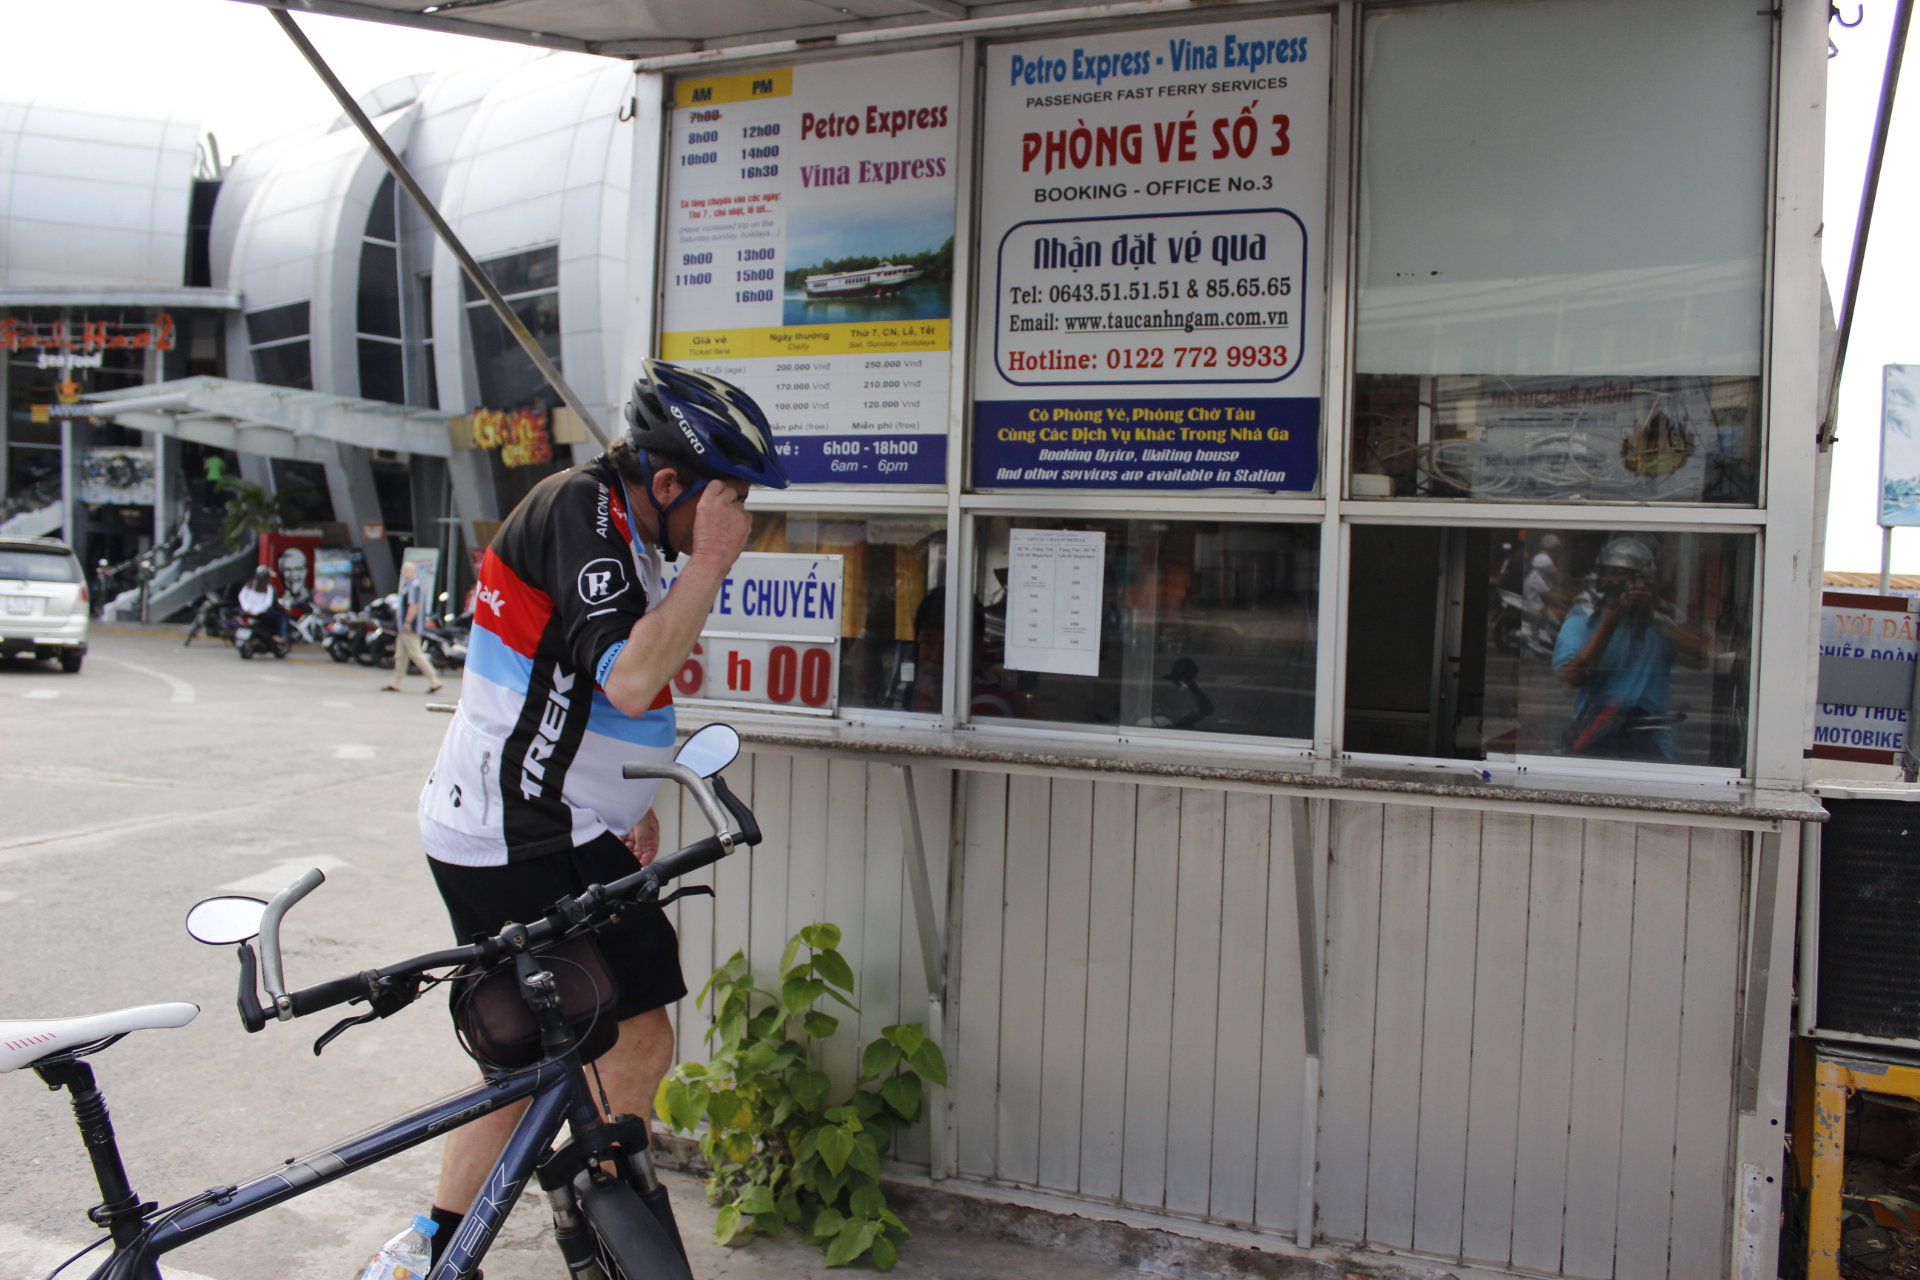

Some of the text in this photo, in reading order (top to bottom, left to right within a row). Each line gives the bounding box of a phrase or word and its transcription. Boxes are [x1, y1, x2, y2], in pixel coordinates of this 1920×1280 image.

[1011, 54, 1067, 86] Petro
[1073, 48, 1150, 85] Express
[1169, 39, 1217, 72] Vina
[1224, 34, 1308, 72] Express
[692, 79, 773, 102] AM PM
[1026, 77, 1288, 108] PASSENGER FAST FERRY SERVICES
[801, 105, 948, 140] Petro Express
[688, 123, 781, 145] 8h00 12h00
[1022, 99, 1291, 175] PHÒNG VÉ SỐ 3
[680, 145, 779, 166] 10h00 14h00
[740, 164, 778, 179] 16h30
[800, 157, 946, 188] Vina Express
[1034, 182, 1127, 202] BOOKING
[1146, 178, 1221, 196] OFFICE
[1228, 174, 1273, 192] No.3
[683, 248, 775, 266] 9h00 13h00
[1033, 230, 1267, 273] Nhận đặt vé qua
[675, 268, 774, 286] 11h00 15h00
[735, 289, 773, 303] 16h00
[1010, 276, 1291, 304] Tel: 0643.51.51.51 & 85.65.65
[1009, 308, 1289, 333] Email: www.taucanhngam.com.vn
[155, 313, 174, 351] 2
[788, 341, 809, 351] Daily
[776, 362, 811, 372] 200.000
[865, 359, 901, 369] 250.000
[1008, 345, 1288, 371] Hotline: 0122 772 9933
[775, 381, 810, 391] 170.000
[864, 379, 900, 389] 210.000
[775, 401, 809, 411] 100.000
[863, 399, 899, 409] 120.000
[678, 420, 705, 454] GIRO
[1180, 427, 1226, 443] Trong
[1267, 427, 1290, 442] Ga
[823, 441, 860, 455] 6h00
[873, 440, 918, 455] 18h00
[1039, 449, 1240, 463] Booking Office, Waiting house
[831, 460, 858, 472] 6am
[878, 459, 908, 475] 6pm
[996, 468, 1286, 483] And other services are available in Station
[742, 562, 836, 620] CHUYẾN
[1834, 613, 1874, 637] NƠI
[727, 651, 751, 691] h
[519, 661, 576, 802] TREK
[1814, 726, 1904, 749] MOTOBIKE
